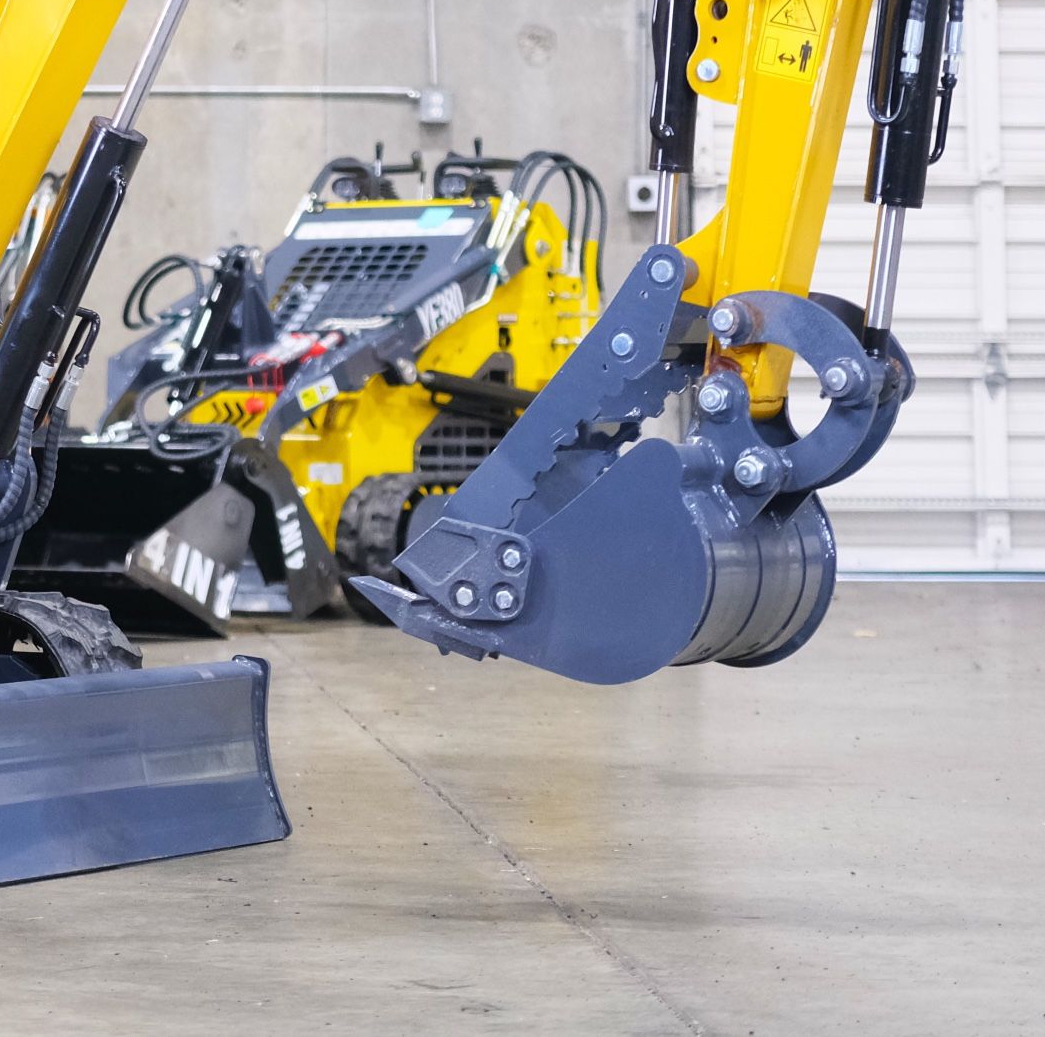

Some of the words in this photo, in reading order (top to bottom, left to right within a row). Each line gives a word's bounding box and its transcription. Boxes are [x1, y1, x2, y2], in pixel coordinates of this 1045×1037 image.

[279, 518, 303, 554] IN
[142, 527, 170, 573] 4
[170, 541, 215, 605] IN
[214, 570, 236, 620] 1
